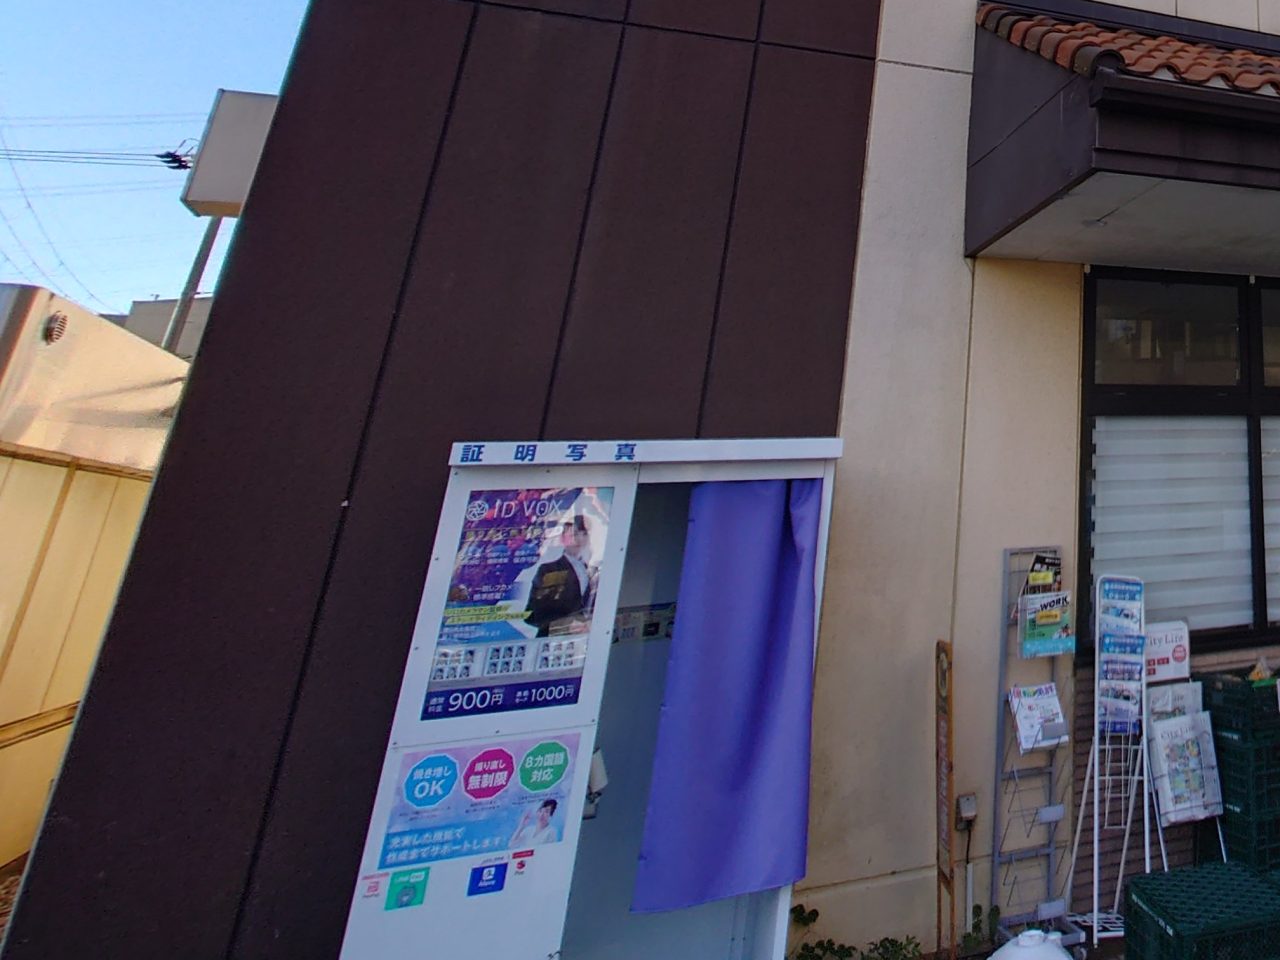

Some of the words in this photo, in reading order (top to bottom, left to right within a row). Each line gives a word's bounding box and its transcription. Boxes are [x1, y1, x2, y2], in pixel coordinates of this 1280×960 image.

[460, 443, 637, 463] 証明写真
[413, 779, 446, 799] OK
[467, 771, 508, 790] 無制限
